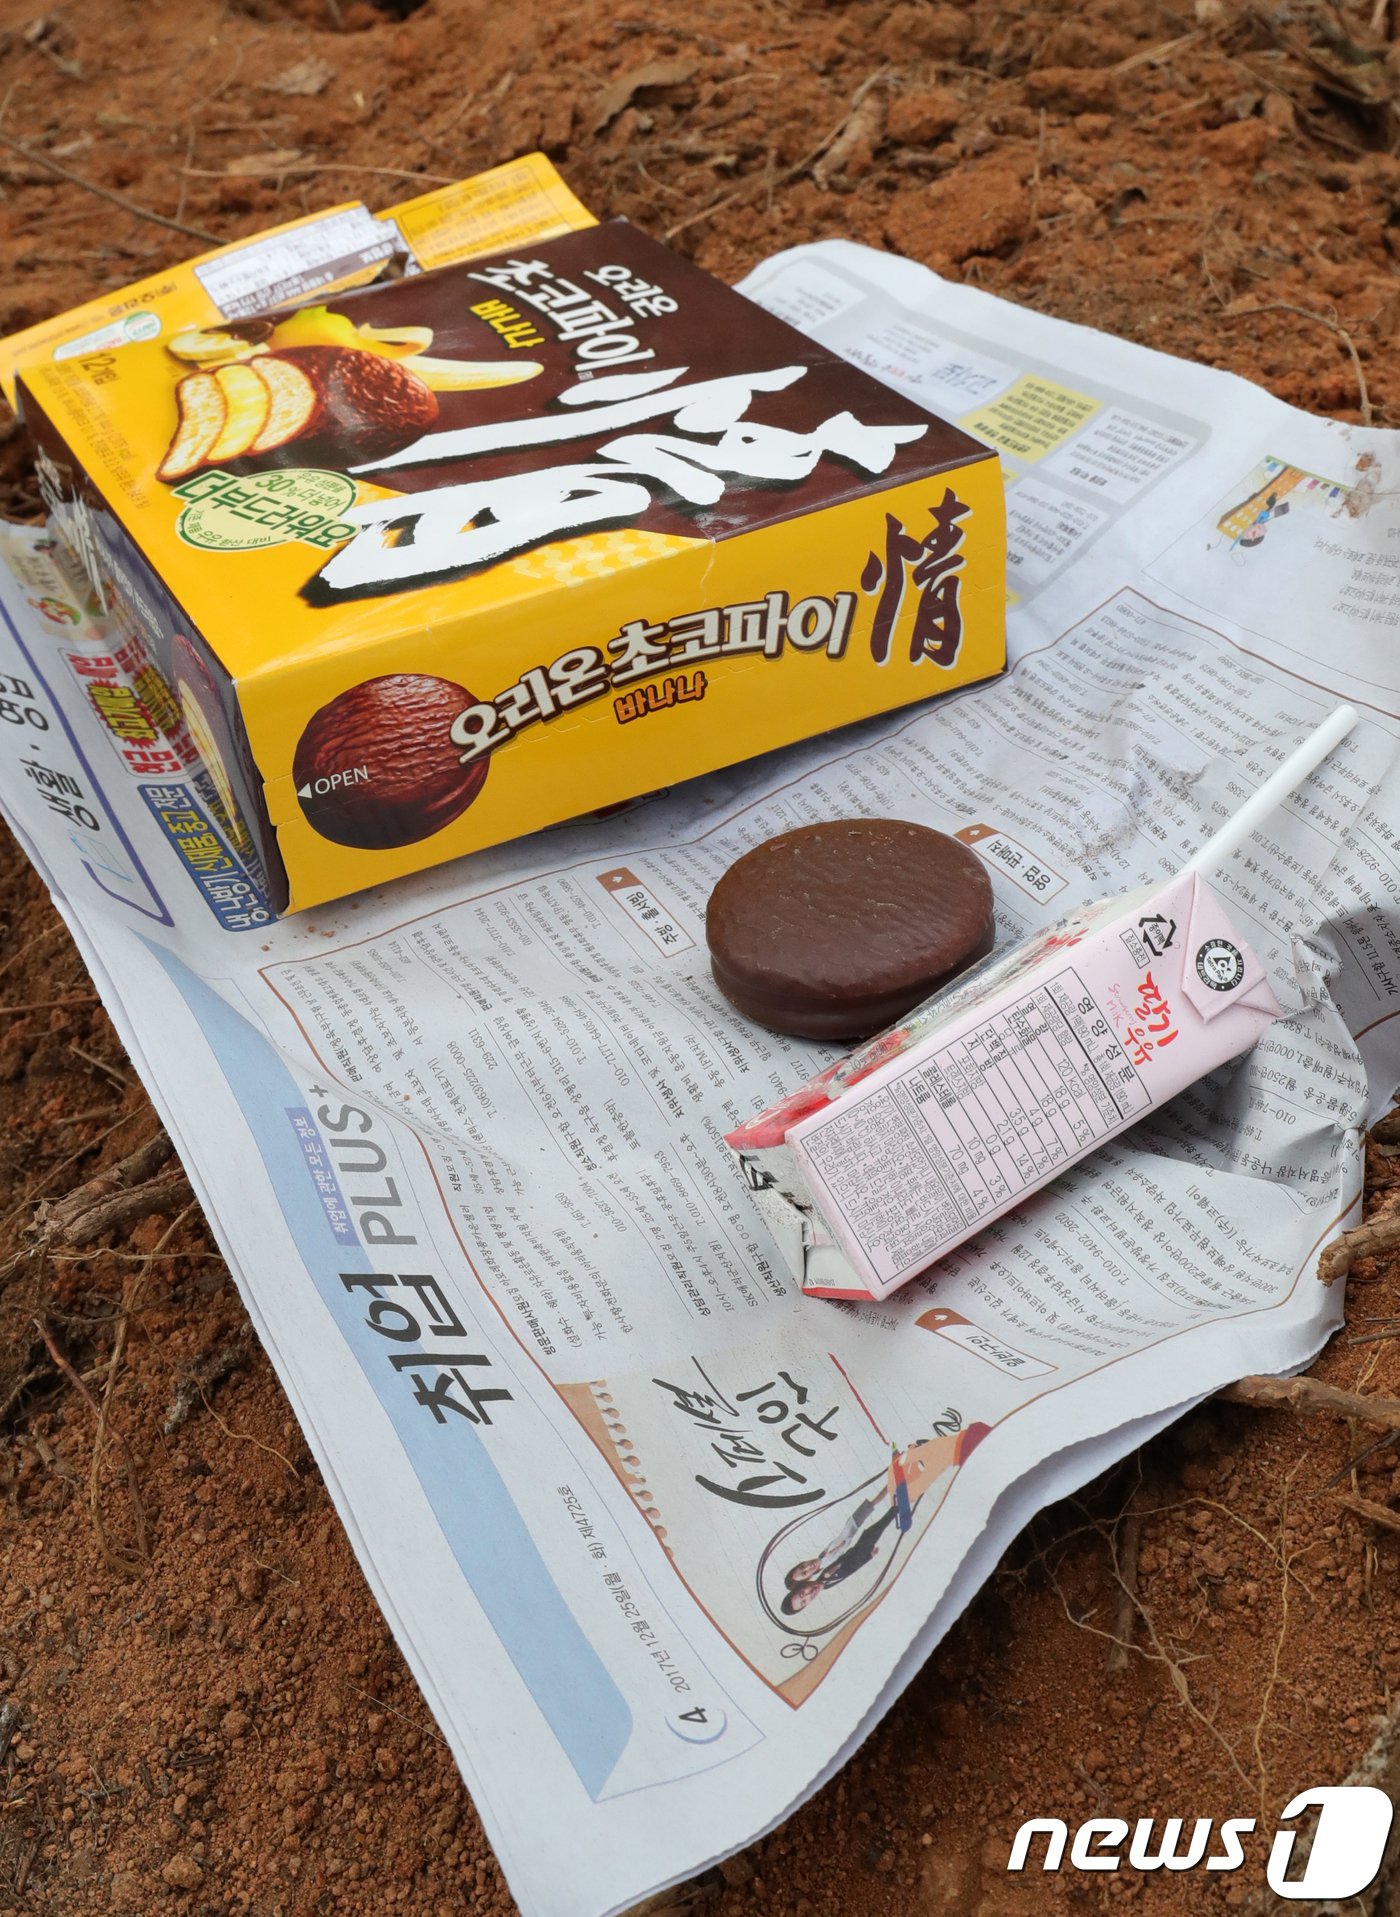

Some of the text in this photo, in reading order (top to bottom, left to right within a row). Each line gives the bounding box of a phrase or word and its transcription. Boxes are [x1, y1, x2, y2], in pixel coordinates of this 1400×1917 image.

[466, 259, 655, 372] 초코파이
[583, 264, 679, 318] 오리온
[469, 299, 546, 350] 바나나
[174, 472, 356, 548] 더부드러워요
[860, 487, 974, 670] 情
[615, 672, 708, 724] 바나나
[315, 763, 370, 797] OPEN
[1215, 865, 1259, 905] 새벽2시~오후
[1258, 869, 1296, 901] 외국인가능
[1124, 933, 1148, 963] 질소충전
[1148, 921, 1167, 946] 종이팩
[1371, 961, 1399, 996] 기사구함
[368, 1006, 398, 1048] 초보자가능
[1004, 1010, 1038, 1047] 탄수화물
[1041, 1002, 1074, 1047] 제공량당 함량
[1136, 971, 1179, 1053] 딸기
[346, 1018, 383, 1073] 여상담후결정
[467, 1027, 499, 1071] 229-6311
[492, 1015, 563, 1119] 오전6시부터근무 급여상담
[530, 1029, 565, 1076] 315-6번지
[618, 1023, 653, 1067] 코디네이터
[651, 1030, 704, 1103] 생활비 운동지원금
[713, 1030, 751, 1074] 치위생사구함
[1057, 992, 1135, 1114] 제공량 제공량 (190 mL)
[1122, 1025, 1154, 1069] 우유
[404, 1067, 428, 1097] 초보자
[446, 1040, 498, 1120] T.(063)225-0008
[558, 1074, 583, 1104] 상평리
[655, 1078, 685, 1119] 치위생사
[707, 1069, 726, 1089] 송동
[940, 1063, 972, 1101] 트랜스지방
[956, 1054, 1011, 1136] 포화지방 2.1
[1056, 1057, 1087, 1100] 120 kcal
[1083, 1073, 1121, 1125] 영양성분 기준치
[578, 1104, 600, 1134] 옥구읍
[602, 1098, 641, 1151] 토불한증막]
[908, 1075, 970, 1175] 나트륨 70 mg
[922, 1063, 987, 1166] 콜레스테롤 10 mg
[1008, 1107, 1027, 1127] 3.5
[595, 1134, 619, 1163] 후결정
[858, 1099, 950, 1243] 경우 음용하지 후에는 반드시 냉장보관
[863, 1134, 883, 1158] 하시고
[871, 1153, 900, 1186] 유통기한
[302, 1138, 350, 1238] 취업에 관한 모든
[805, 1132, 866, 1224] 변질의 우려가 있으니 드시지
[818, 1124, 911, 1271] 전자레인지에 넣지 경과된 제품은
[833, 1116, 925, 1262] 드시기 드실 경우 포장된 함께
[889, 1179, 913, 1210] 이내라도
[900, 1140, 965, 1235] 손상되었거나 내용물이 변질되었을
[927, 1141, 980, 1221] 영양성분기준치에 대한 비율
[553, 1192, 592, 1229] T.461-5850
[578, 1181, 628, 1233] 010-5637-7004
[653, 1150, 759, 1308] SK매직군산지점] T.010-8669-7953
[679, 1132, 787, 1297] 생산직원구함 오전8시30분~오후
[912, 1220, 930, 1238] 시일
[1124, 1167, 1279, 1294] 300만지원 상해보험무료가입 차량소유자
[1185, 1184, 1239, 1240] [(주)코웨이]
[618, 1185, 712, 1317] 상담관리직원모집 2명 25세~55세
[1054, 1212, 1130, 1286] T.010-9402-2602
[1090, 1204, 1160, 1273] 가정방문필터교환
[1101, 1179, 1223, 1292] 월평균200만이상 정착지원금연
[666, 1213, 736, 1313] 10시~오후4시 주5일근무
[989, 1261, 1047, 1315] 아르바이트(오후
[1011, 1243, 1088, 1315] 시급상담후결정 12월
[505, 1287, 557, 1356] 방문판매사원모집
[556, 1269, 608, 1342] 가능 투자비용없음
[588, 1270, 634, 1335] 한사항전화문의
[343, 1271, 515, 1427] 취업
[967, 1327, 1025, 1368] 일반구인
[650, 1354, 827, 1510] 스페셜
[735, 1370, 840, 1458] 구인
[556, 1484, 596, 1540] 제4725호
[630, 1619, 659, 1648] 12월
[650, 1649, 691, 1694] 2017년
[678, 1706, 709, 1724] 4
